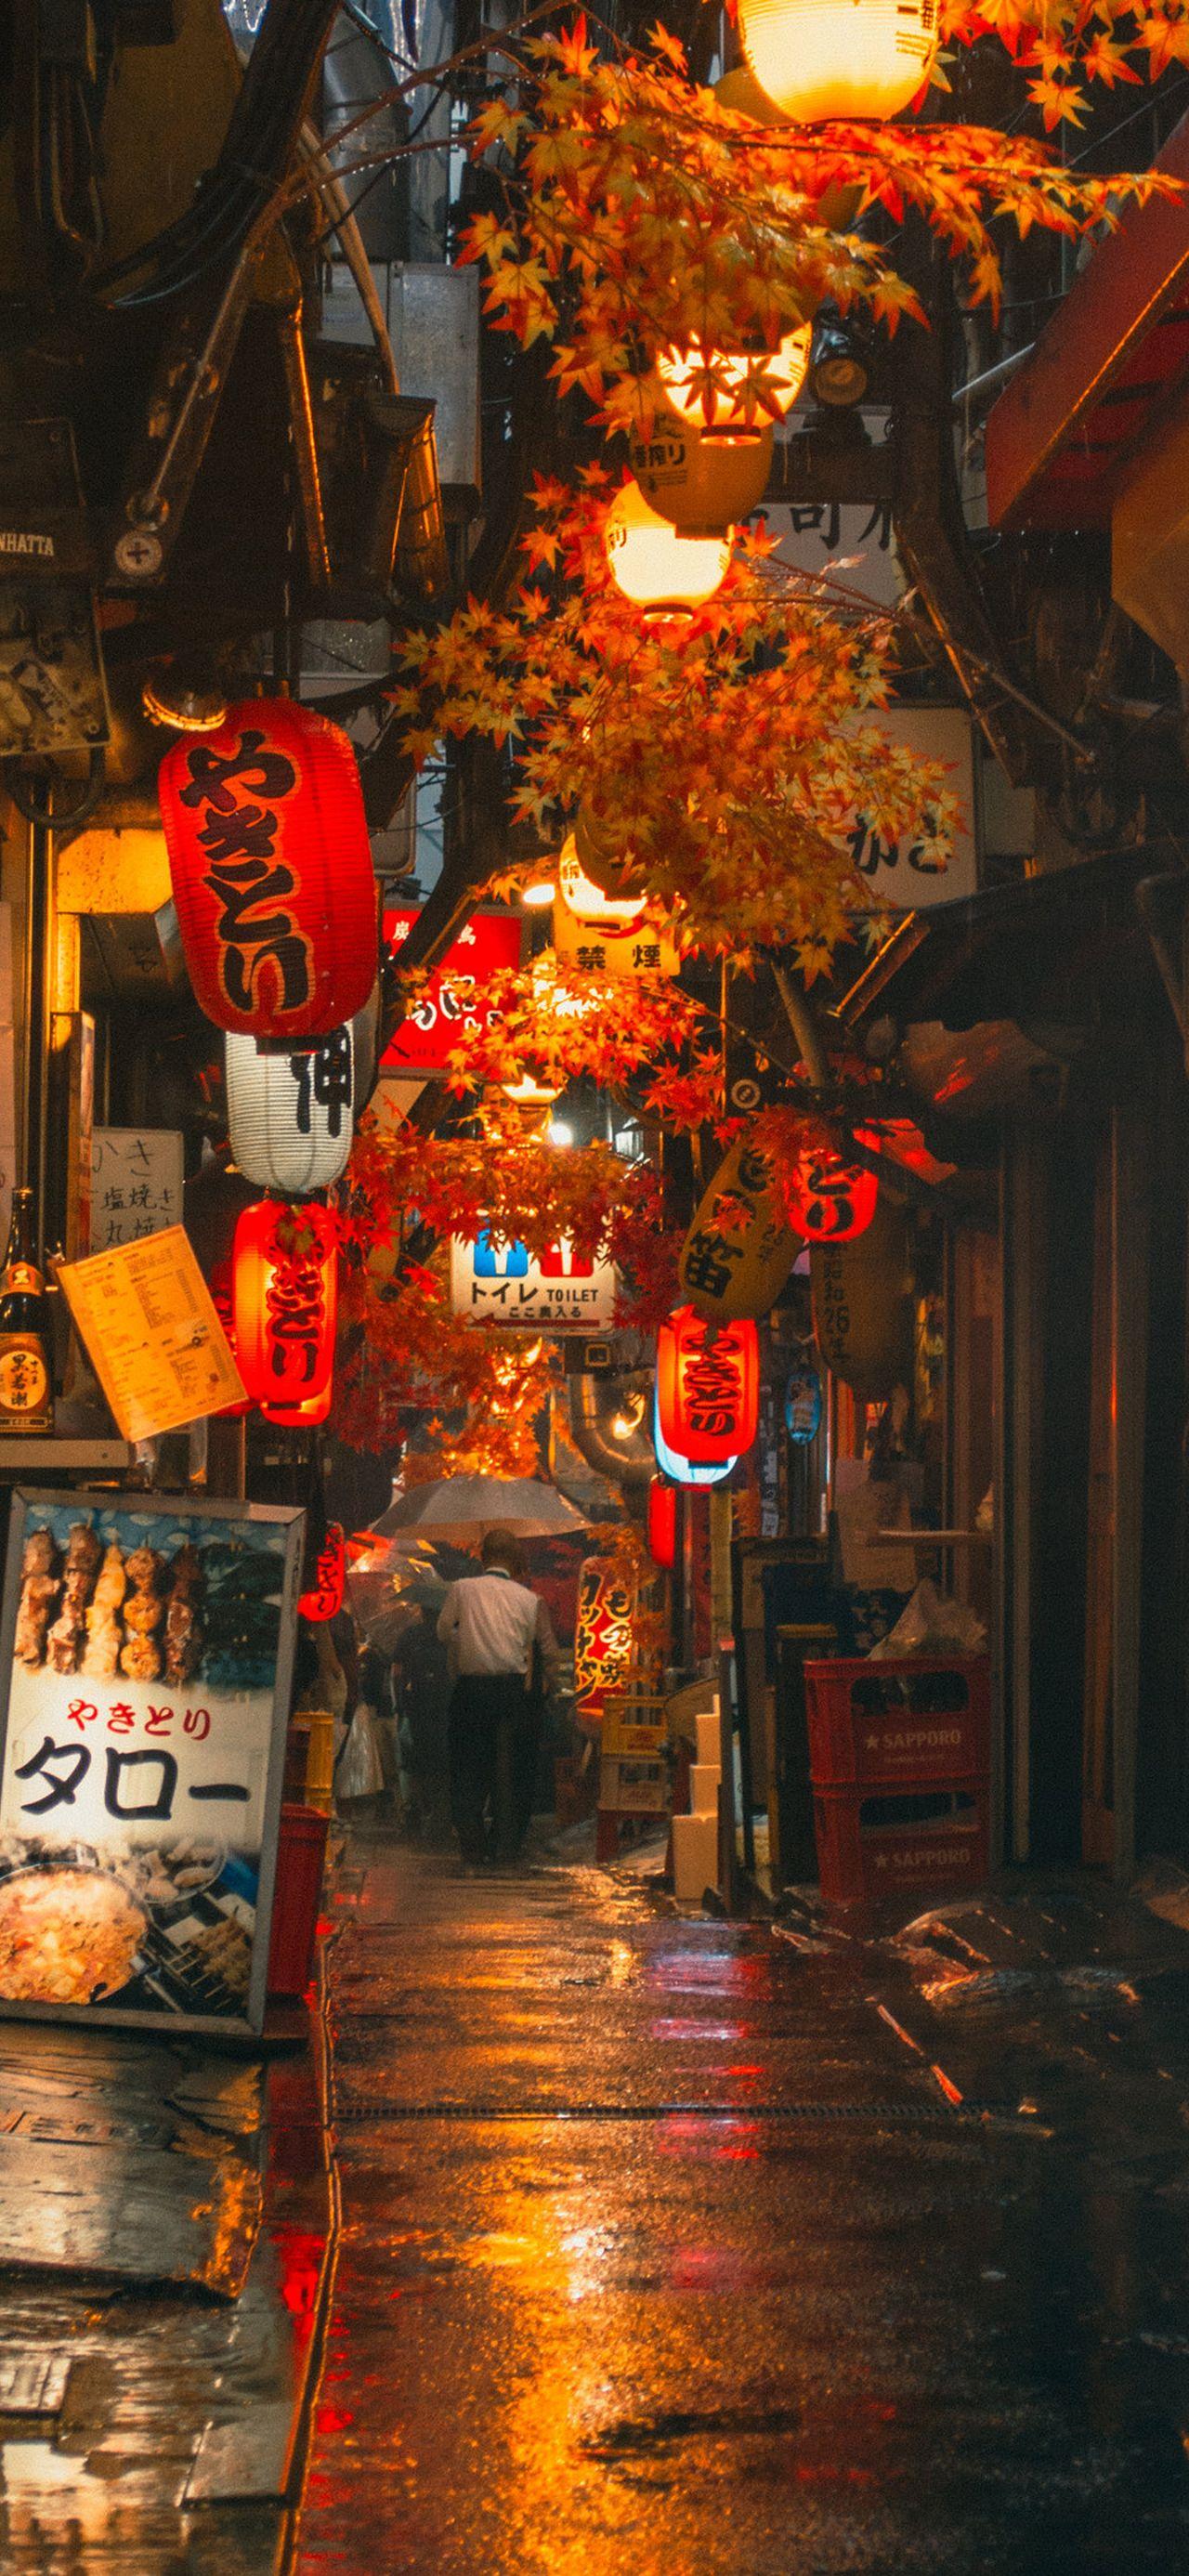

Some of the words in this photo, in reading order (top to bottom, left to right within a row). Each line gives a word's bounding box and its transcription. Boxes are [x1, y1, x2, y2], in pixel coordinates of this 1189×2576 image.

[179, 730, 309, 1012] やきとり
[576, 945, 661, 970] 禁煙
[472, 1282, 539, 1303] トイレ
[547, 1289, 599, 1301] TOILET
[509, 1307, 582, 1318] ここ奥入る
[685, 1335, 741, 1436] やきとり
[67, 1699, 211, 1741] やきとり
[883, 1729, 961, 1750] SAPPORO
[15, 1735, 251, 1821] タロー
[892, 1850, 972, 1868] SAPPORO
